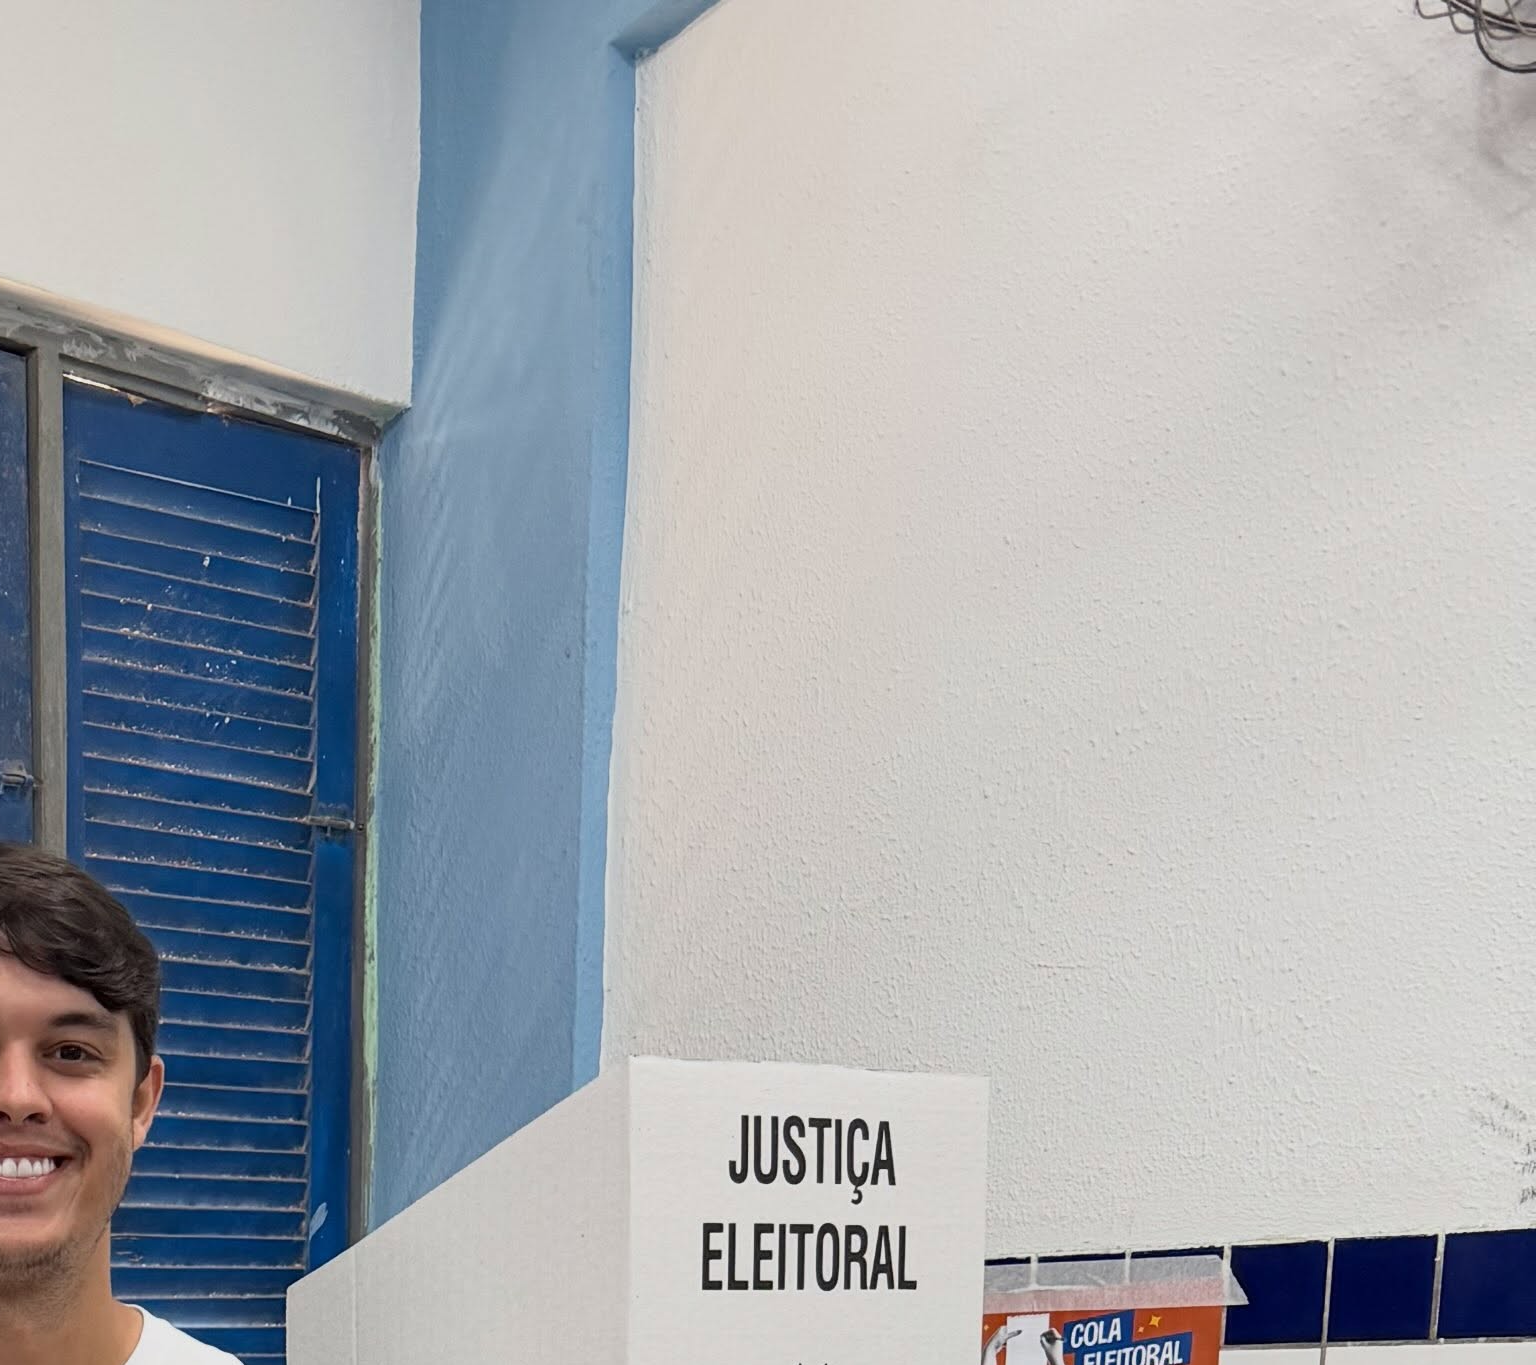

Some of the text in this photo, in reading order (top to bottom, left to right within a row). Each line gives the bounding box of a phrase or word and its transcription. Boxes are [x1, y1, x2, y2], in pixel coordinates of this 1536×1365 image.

[729, 1114, 896, 1205] JUSTIÇA
[702, 1222, 917, 1292] ELEITORAL
[1070, 1318, 1122, 1348] COLA
